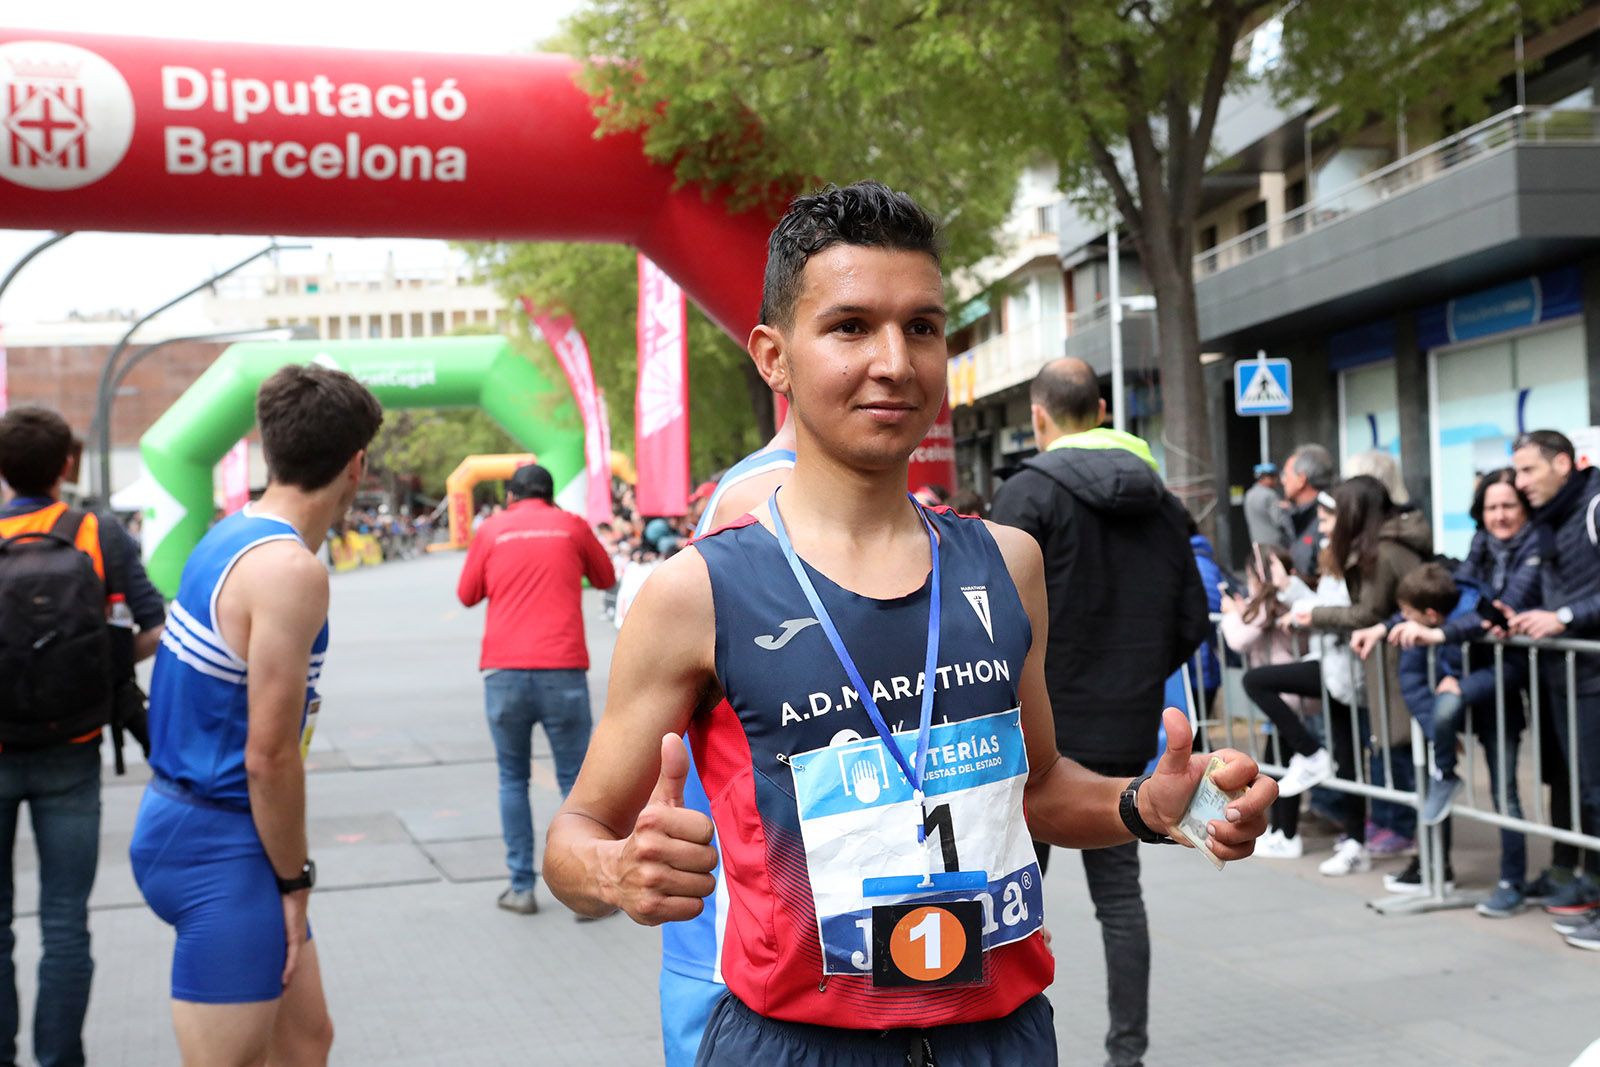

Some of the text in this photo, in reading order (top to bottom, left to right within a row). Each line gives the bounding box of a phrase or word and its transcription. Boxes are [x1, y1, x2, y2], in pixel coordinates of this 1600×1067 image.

[161, 65, 468, 124] Diputació
[164, 126, 468, 182] Barcelona
[907, 767, 957, 784] UESTAS
[958, 764, 975, 775] DEL
[976, 756, 1003, 770] ESTADO
[909, 912, 941, 969] 1
